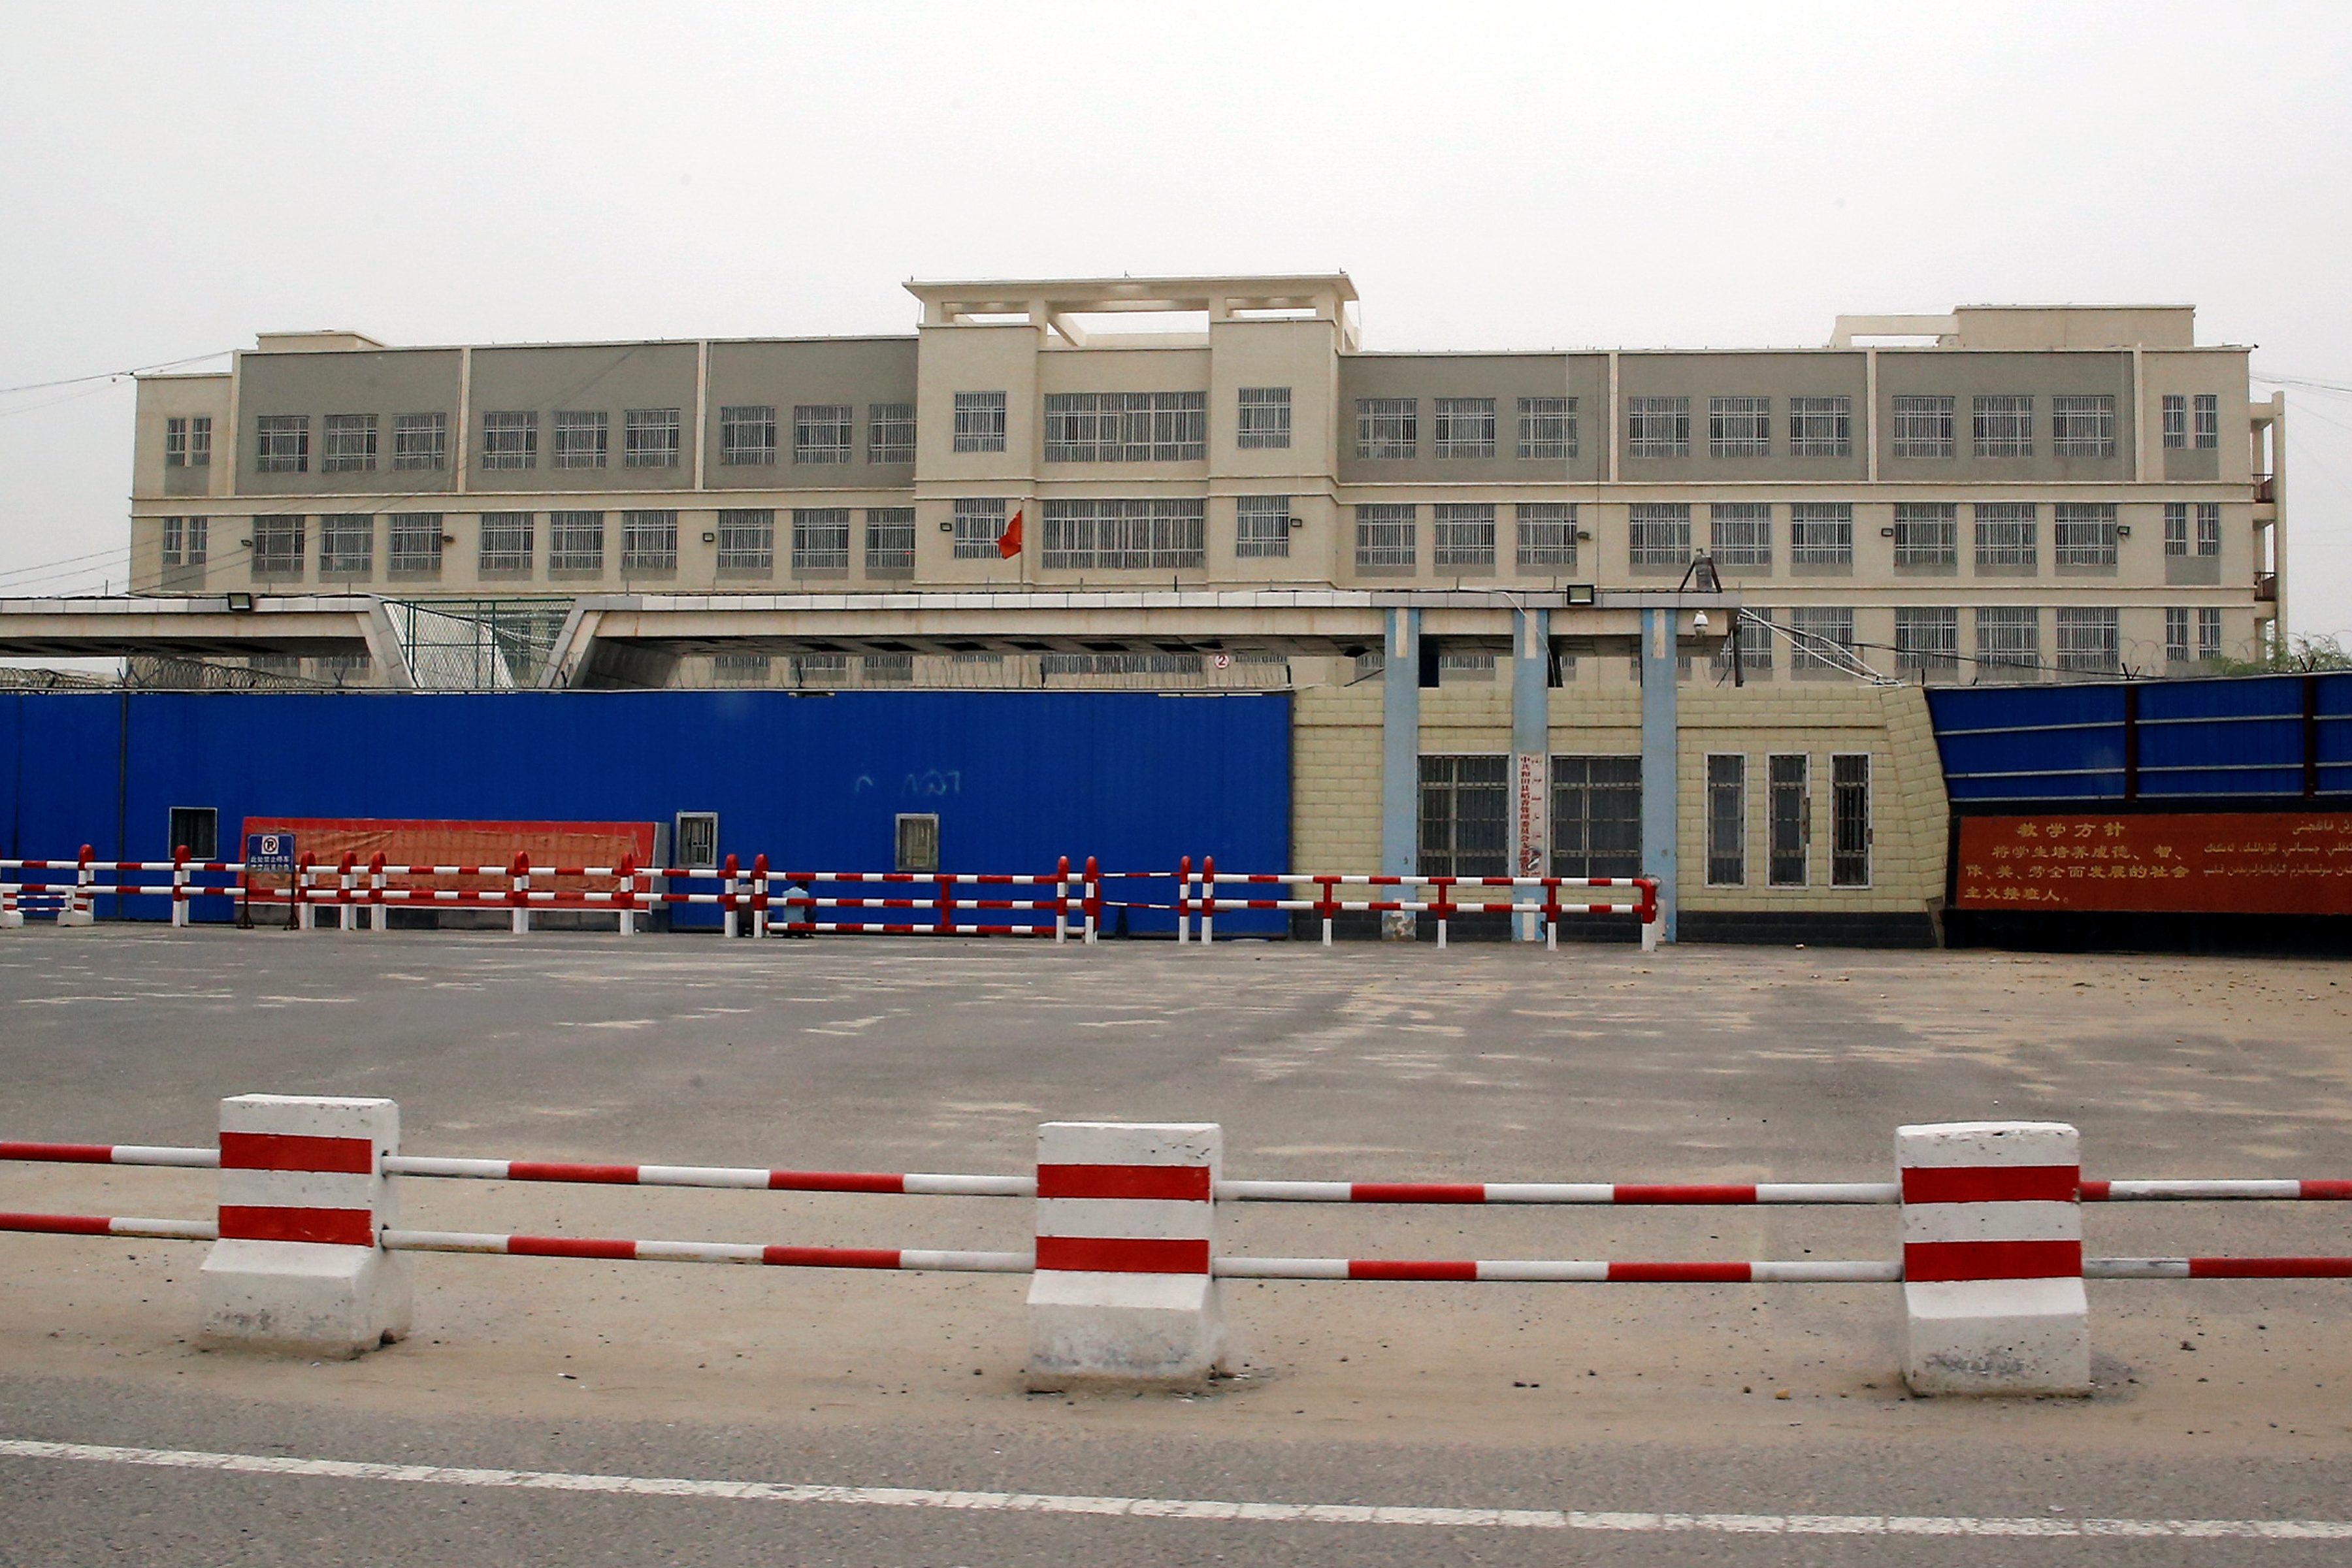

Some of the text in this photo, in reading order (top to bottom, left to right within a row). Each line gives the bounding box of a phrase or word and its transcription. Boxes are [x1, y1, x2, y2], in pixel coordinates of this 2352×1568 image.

[2017, 821, 2125, 838] 教学方针
[1964, 886, 2068, 904] 主义接班人。
